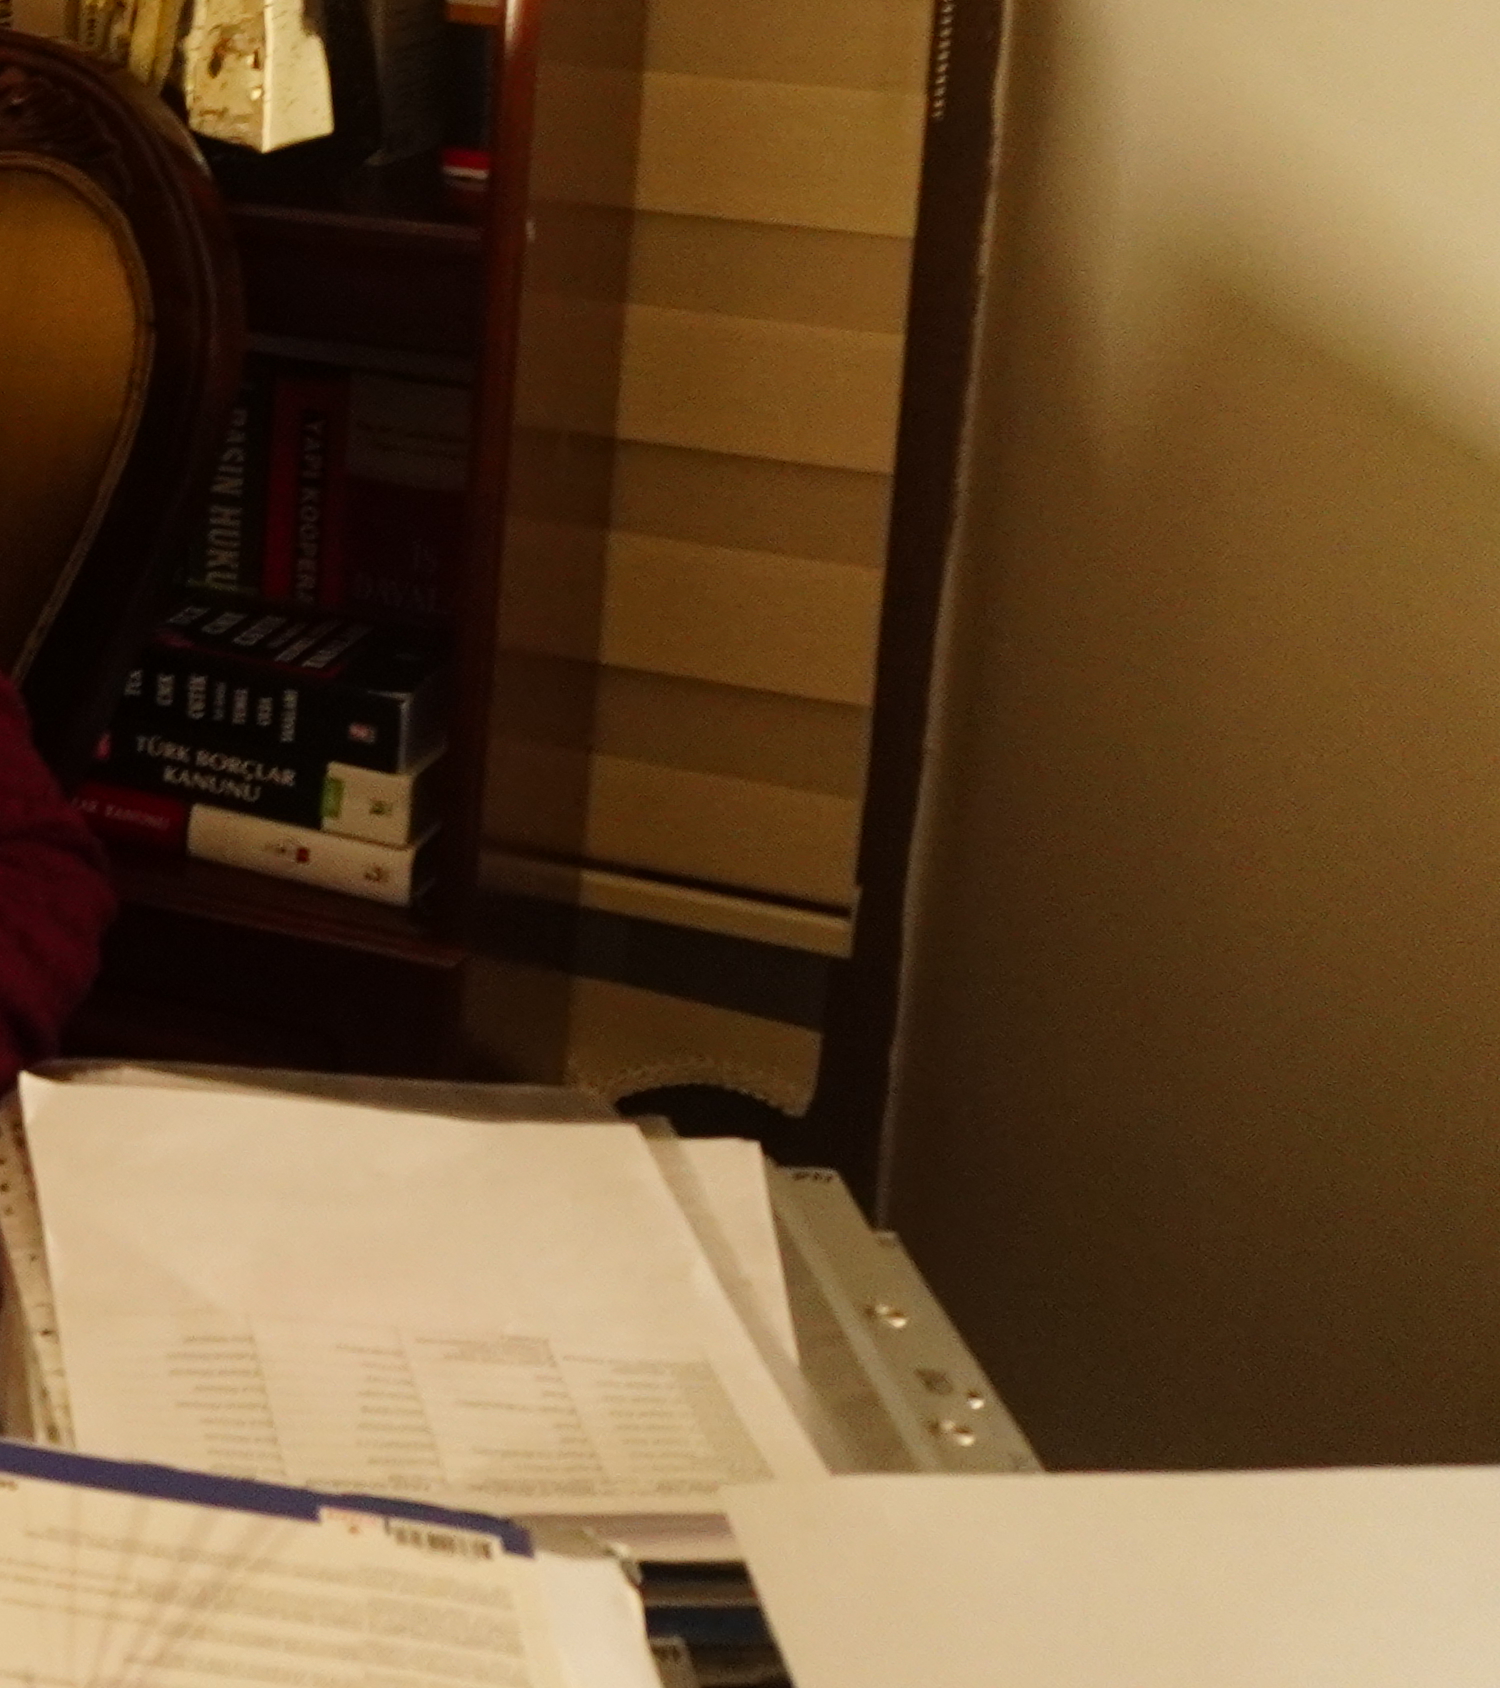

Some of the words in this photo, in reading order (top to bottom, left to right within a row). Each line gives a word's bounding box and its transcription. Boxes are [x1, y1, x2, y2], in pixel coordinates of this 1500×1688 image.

[136, 733, 191, 764] TÜRK
[195, 748, 297, 788] BORÇLAR
[162, 764, 262, 803] KANUNU
